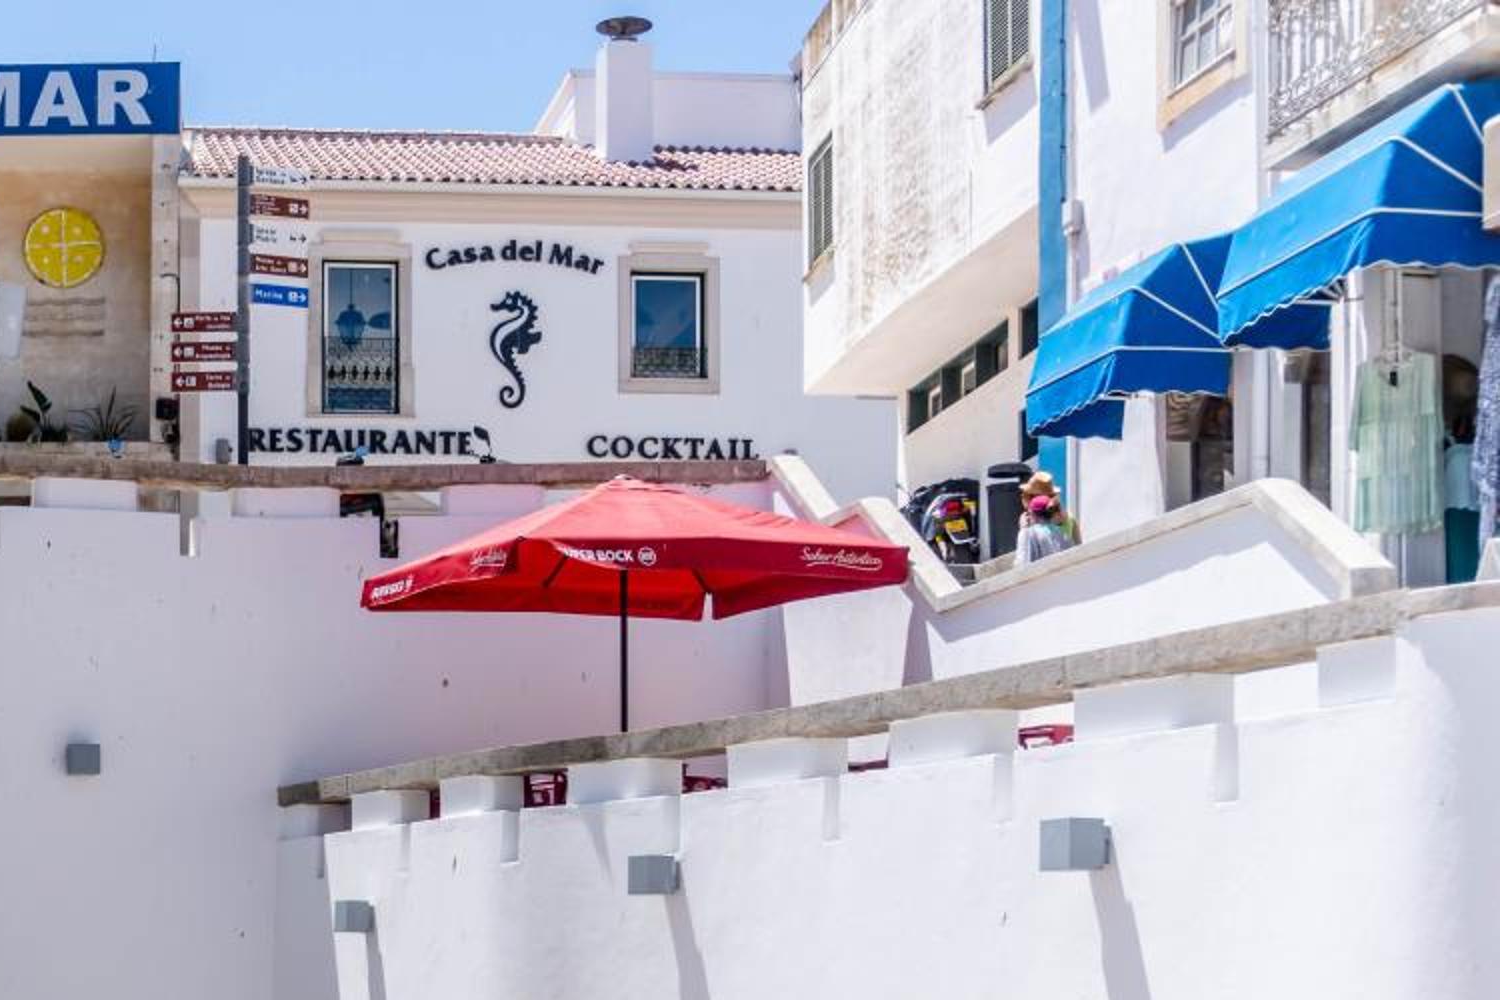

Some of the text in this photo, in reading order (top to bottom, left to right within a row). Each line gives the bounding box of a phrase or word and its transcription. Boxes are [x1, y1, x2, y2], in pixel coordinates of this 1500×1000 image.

[425, 239, 605, 275] Casa del Mar
[248, 427, 760, 461] RESTAURANTE COCKTAIL
